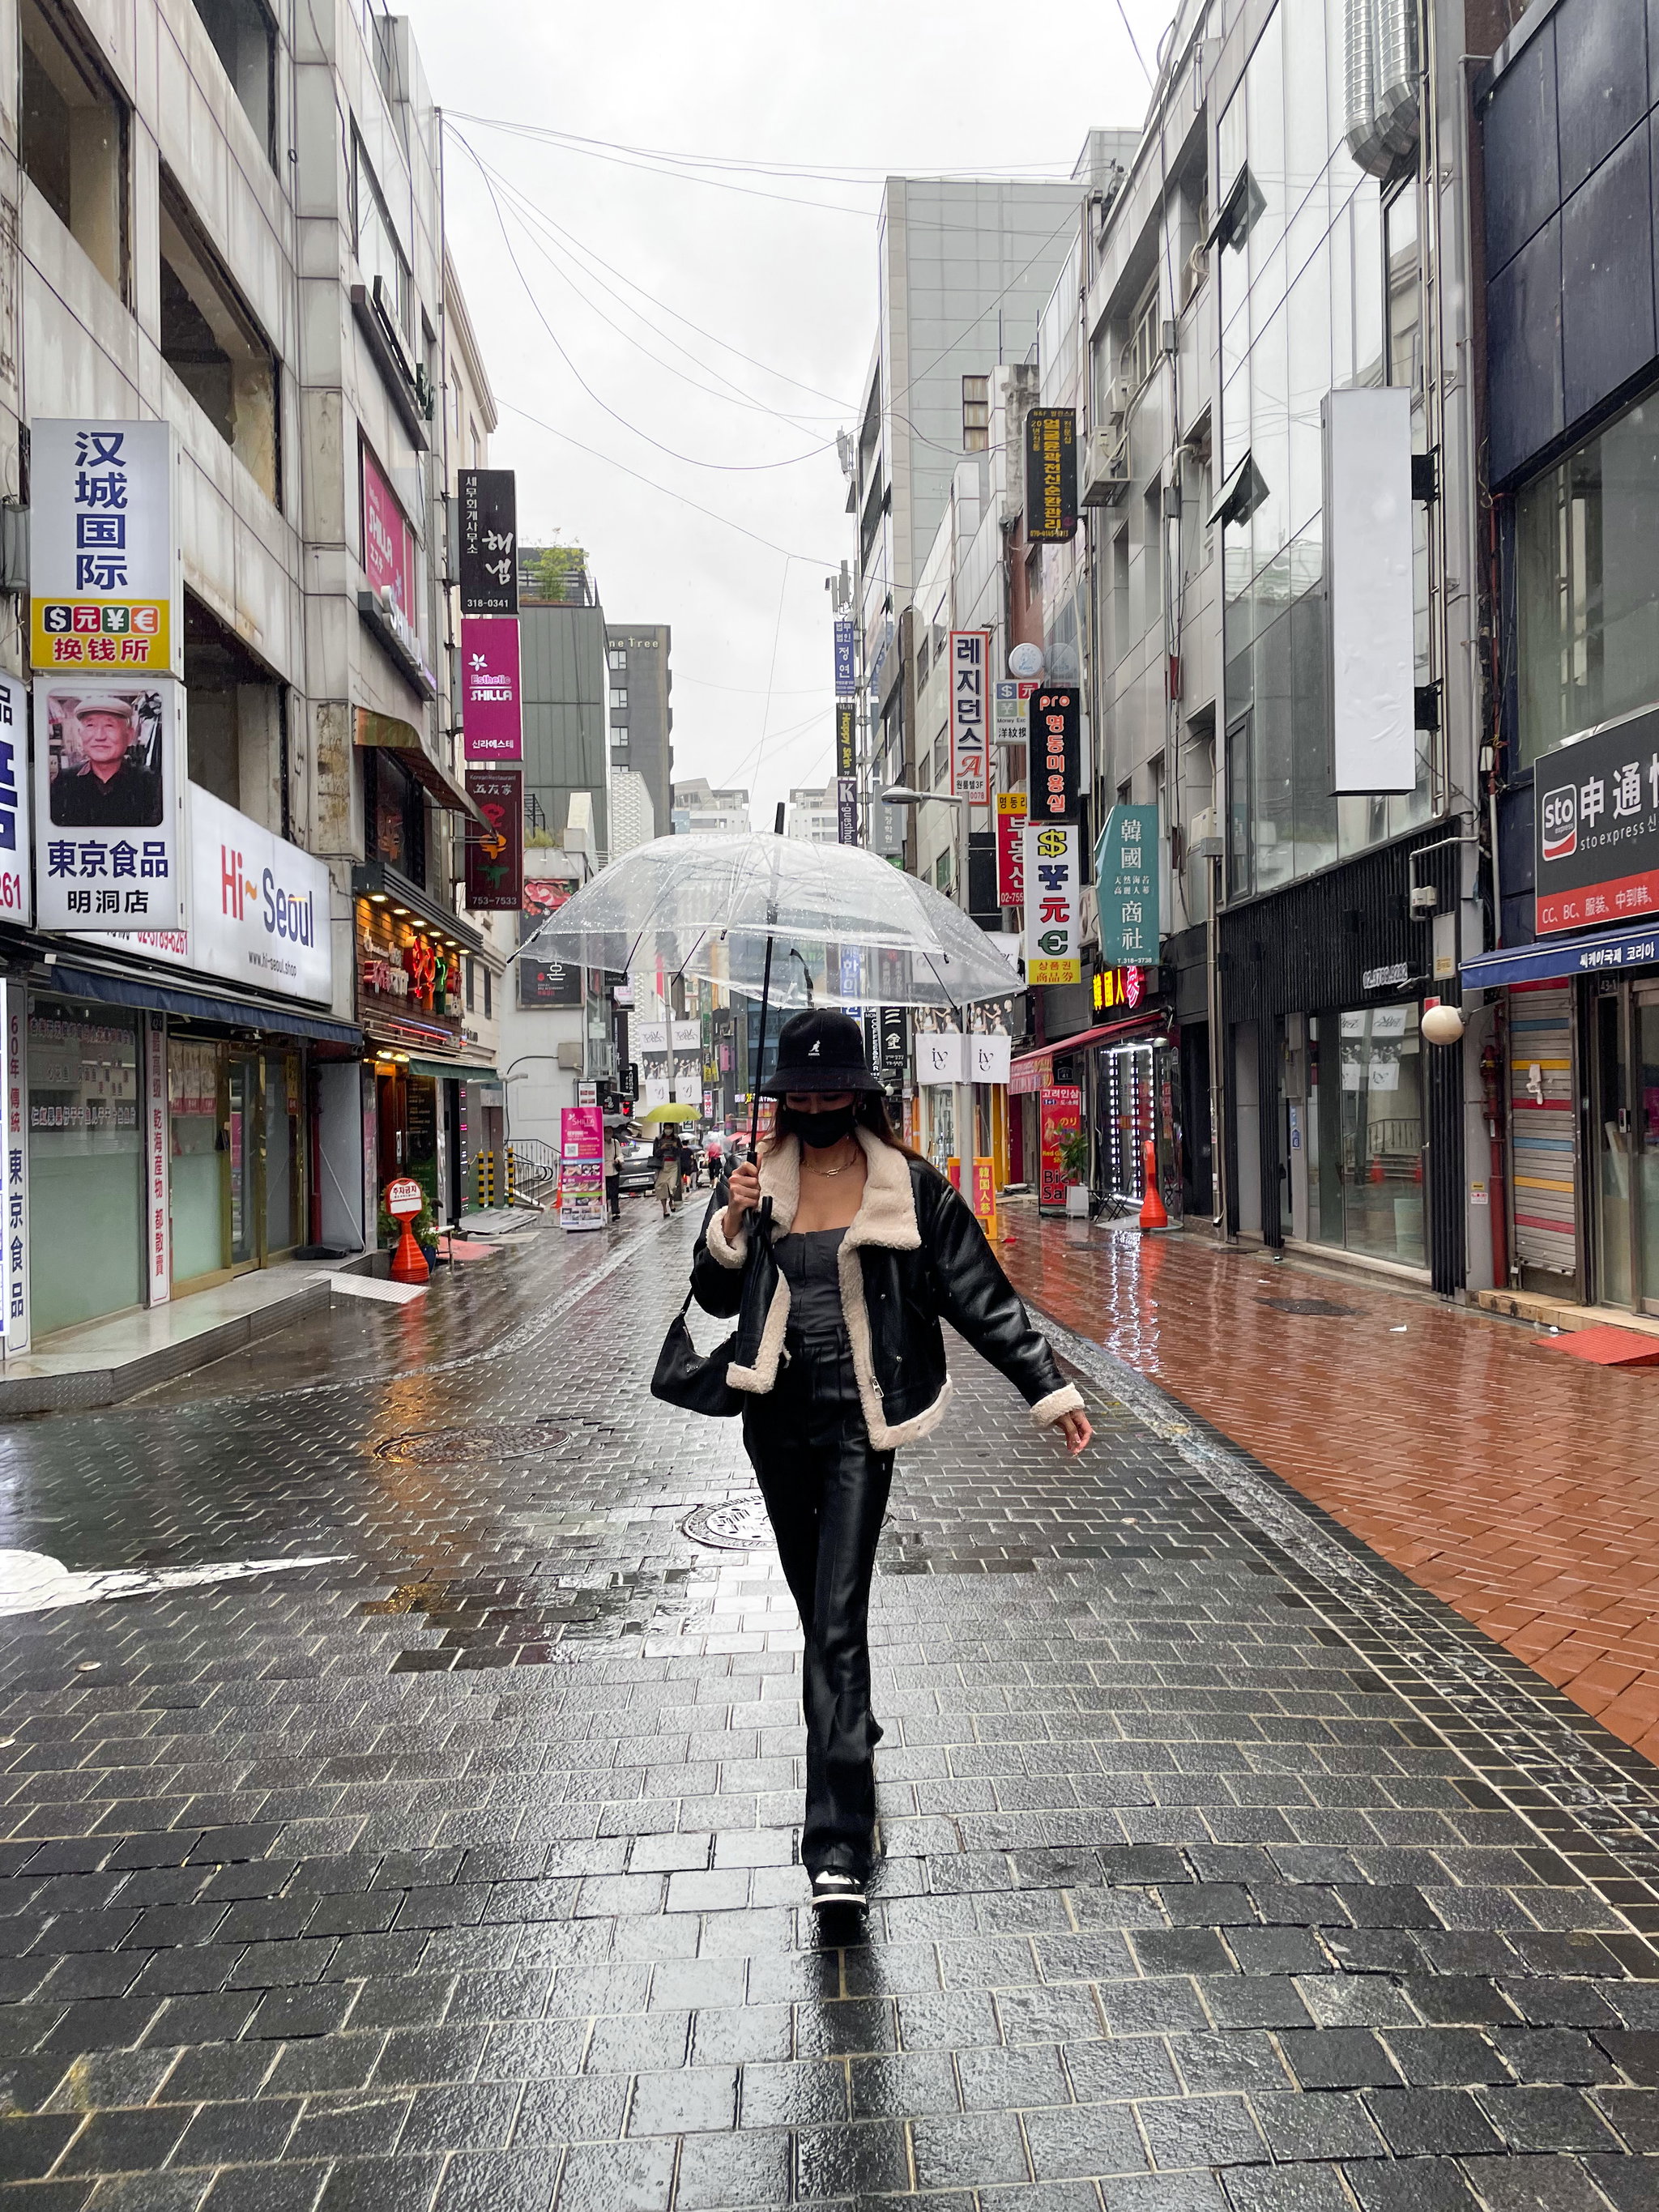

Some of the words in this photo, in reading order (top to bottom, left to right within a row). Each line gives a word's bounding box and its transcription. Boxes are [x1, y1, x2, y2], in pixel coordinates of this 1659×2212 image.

[75, 431, 128, 590] 汉城国际
[466, 476, 478, 555] 세무회계사무소
[467, 599, 509, 608] 318-0341
[76, 609, 97, 629] 元
[54, 638, 148, 662] 换钱所
[839, 646, 850, 679] 정연
[471, 675, 511, 684] Esthetic
[471, 690, 512, 701] SHILLA
[957, 638, 983, 752] 레지던스
[1039, 696, 1070, 711] pro
[841, 712, 851, 744] Happy
[472, 739, 514, 749] 신라에스테
[842, 746, 853, 769] Skin
[957, 755, 983, 777] A
[1046, 714, 1065, 813] 명동미용실
[1546, 796, 1574, 829] sto
[1555, 823, 1574, 834] express
[1038, 829, 1068, 857] $
[1120, 819, 1142, 869] 韓國
[47, 840, 168, 878] 東京食品
[1038, 864, 1068, 890] ¥
[67, 889, 148, 914] 明洞店
[221, 845, 244, 921] Hi
[262, 867, 314, 948] Seoul
[472, 897, 517, 906] 753-7533
[1039, 897, 1070, 923] 元
[1121, 900, 1143, 950] 商社
[1627, 941, 1654, 960] 코리아
[248, 950, 297, 978] www.hi-seoul.shop
[1036, 971, 1073, 982] 商品券
[1038, 961, 1071, 970] 상품권
[10, 1016, 19, 1079] 60年
[1043, 1089, 1079, 1099] 고려인삼
[1060, 1117, 1077, 1126] のり
[393, 1185, 417, 1195] 주차금지
[9, 1148, 23, 1320] 東京食品
